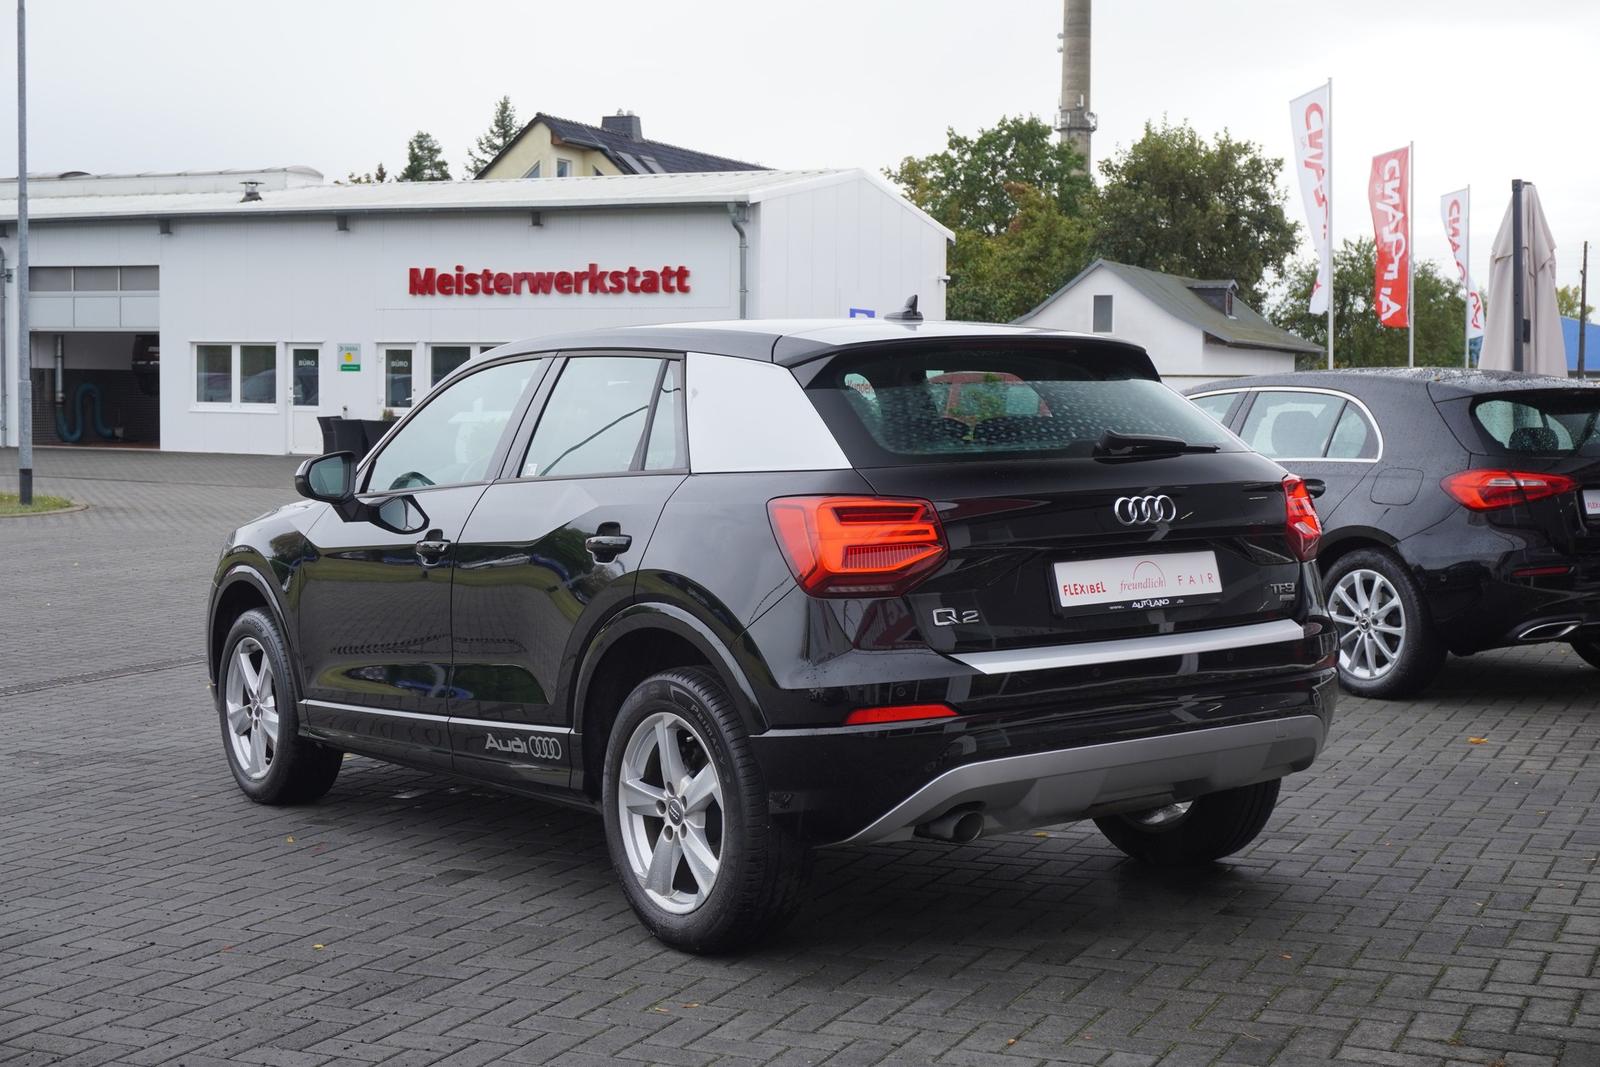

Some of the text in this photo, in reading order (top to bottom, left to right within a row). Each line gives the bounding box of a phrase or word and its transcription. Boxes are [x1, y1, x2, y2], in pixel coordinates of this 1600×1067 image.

[409, 264, 690, 295] Meisterwerkstatt
[298, 358, 316, 367] BÜRO
[391, 359, 408, 368] BÜRO
[1063, 572, 1214, 596] FLEXIBEL freundlich FAIR
[1131, 598, 1170, 609] AUTOLAND
[932, 607, 980, 626] Q2
[484, 733, 528, 754] Audi
